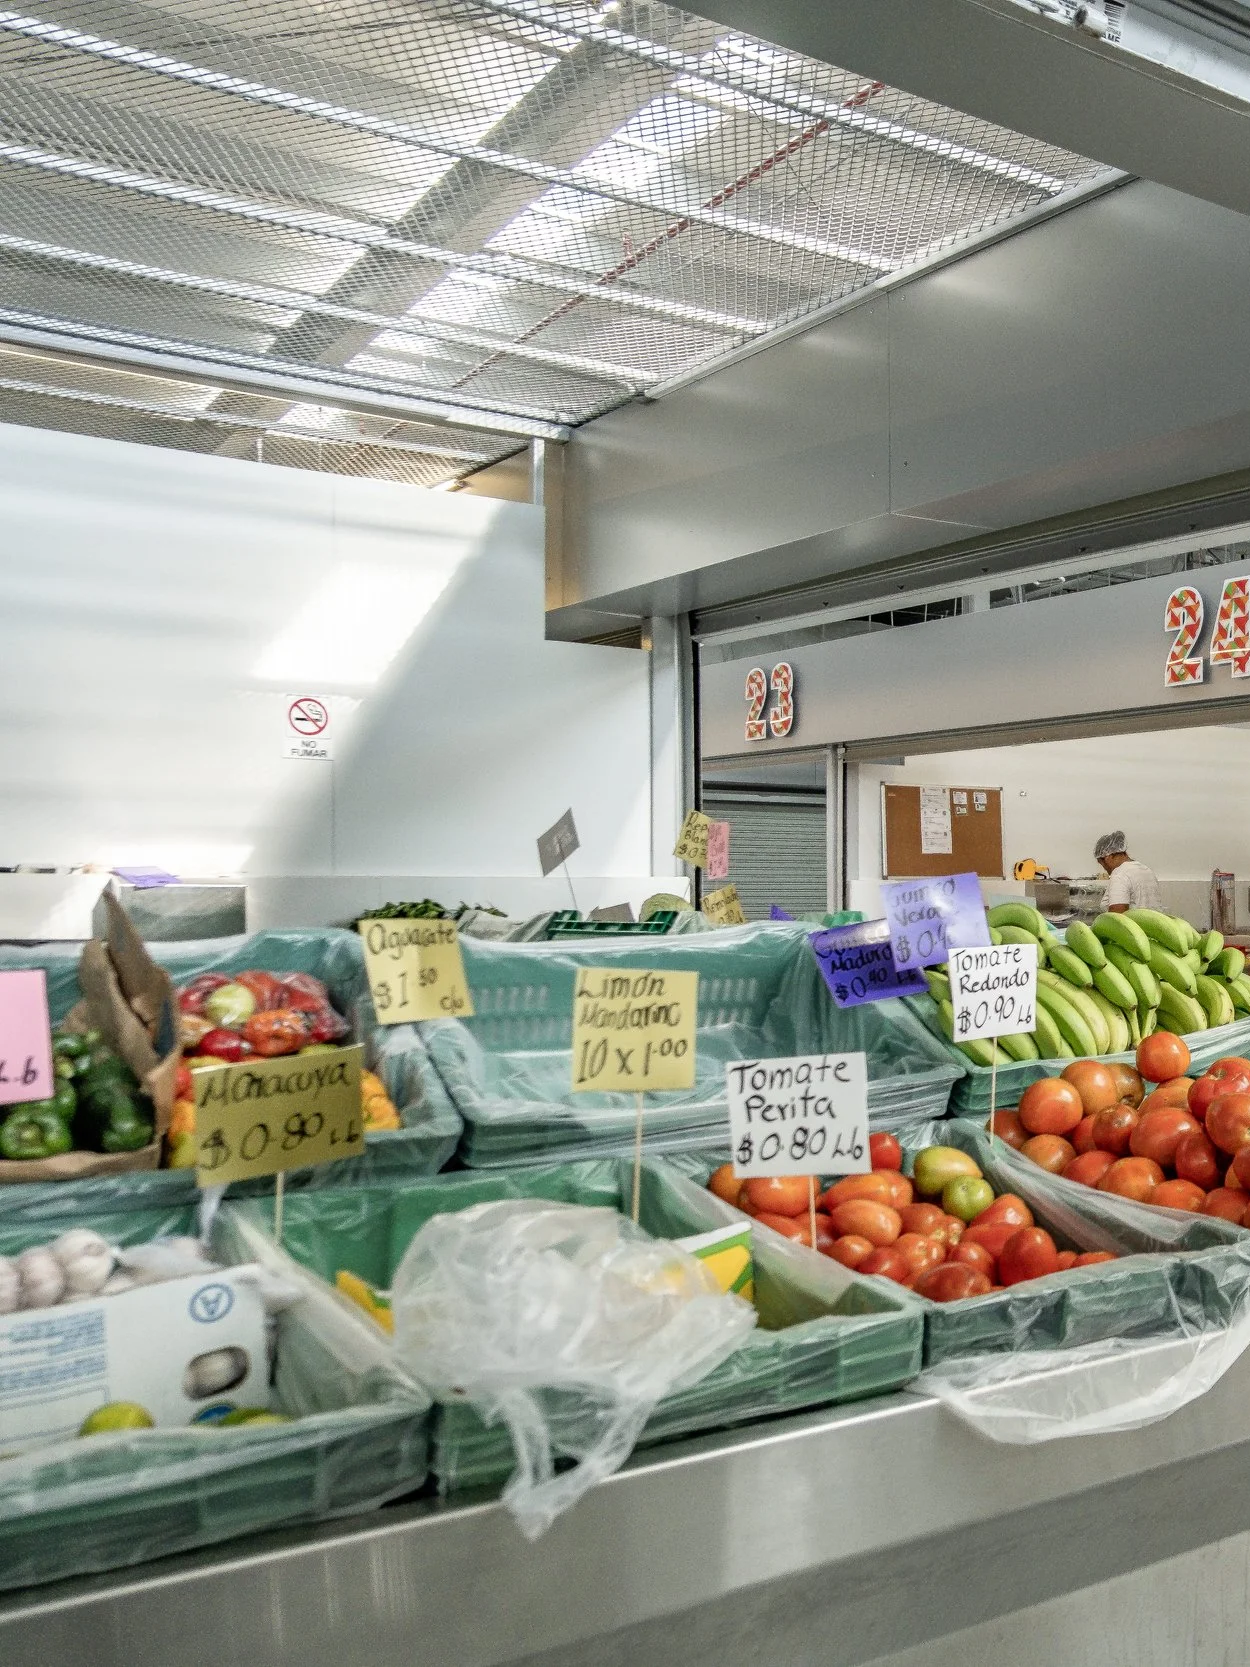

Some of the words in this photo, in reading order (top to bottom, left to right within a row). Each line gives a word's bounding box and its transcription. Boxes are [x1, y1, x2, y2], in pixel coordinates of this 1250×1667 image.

[745, 662, 793, 741] 23
[291, 748, 328, 758] FUMAR
[301, 740, 317, 749] NO
[952, 946, 1022, 973] Tomate
[959, 967, 1030, 995] Redondo
[577, 1038, 608, 1083] 10
[729, 1055, 852, 1094] Tomate
[745, 1085, 837, 1123] Perita
